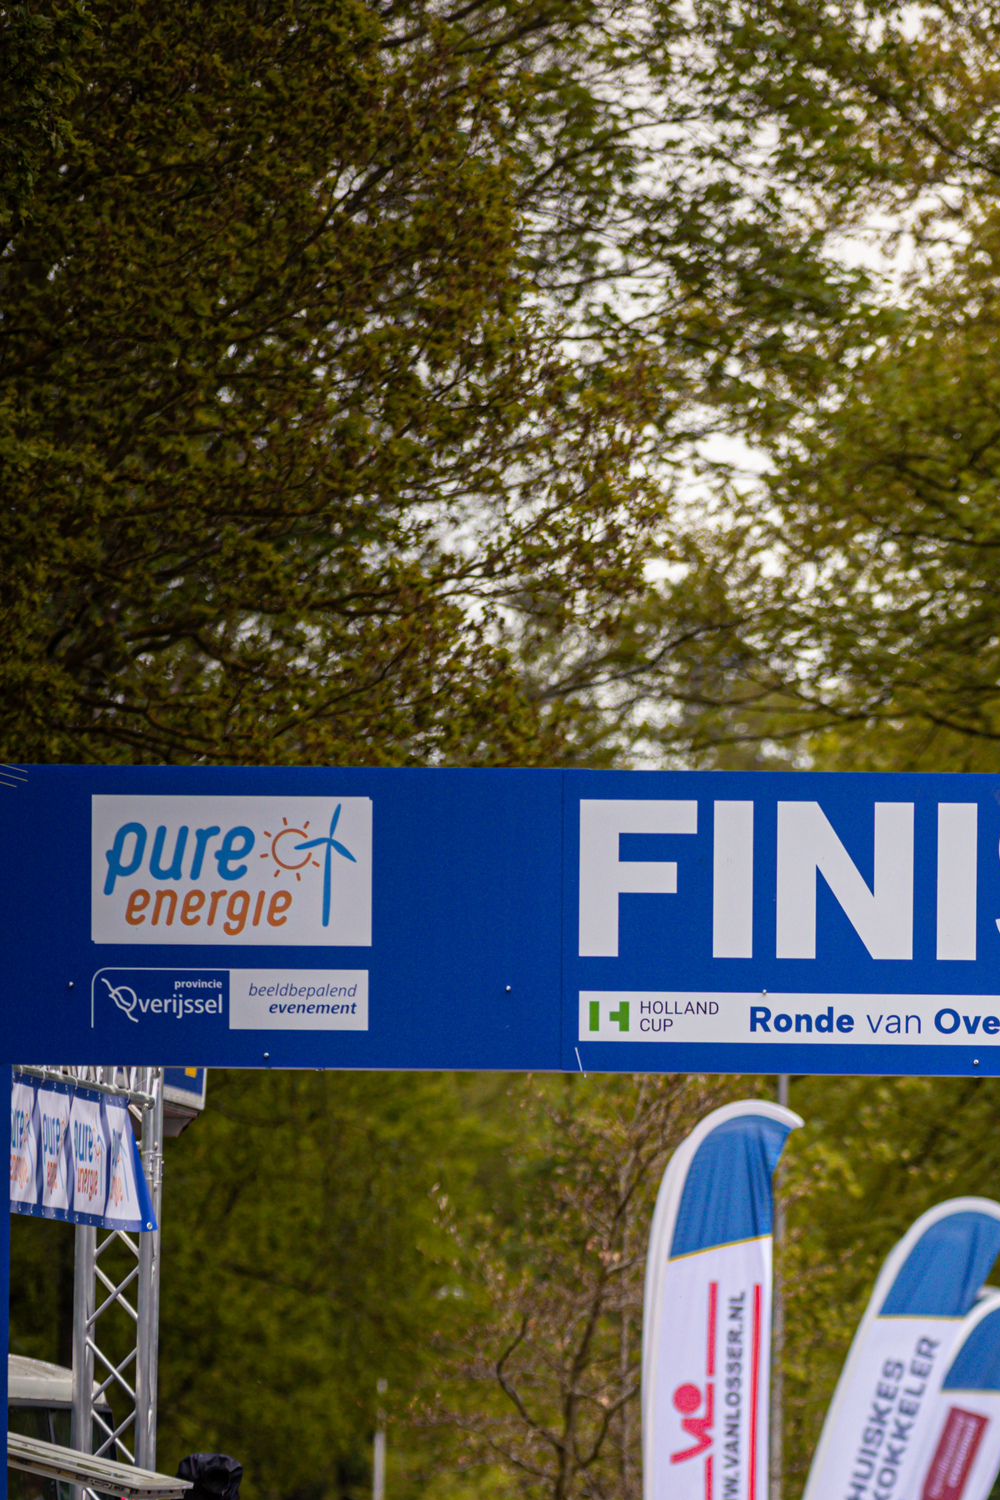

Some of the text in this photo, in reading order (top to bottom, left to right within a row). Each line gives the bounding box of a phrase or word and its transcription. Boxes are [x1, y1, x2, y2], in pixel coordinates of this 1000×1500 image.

[103, 821, 256, 896] pure
[125, 888, 293, 936] energie
[173, 978, 223, 991] provincie
[248, 981, 358, 999] beeldbepalend
[268, 1000, 358, 1016] evenement
[638, 1000, 720, 1016] HOLLAND
[638, 1017, 674, 1033] CUP
[748, 1006, 855, 1035] Ronde
[866, 1012, 923, 1035] van
